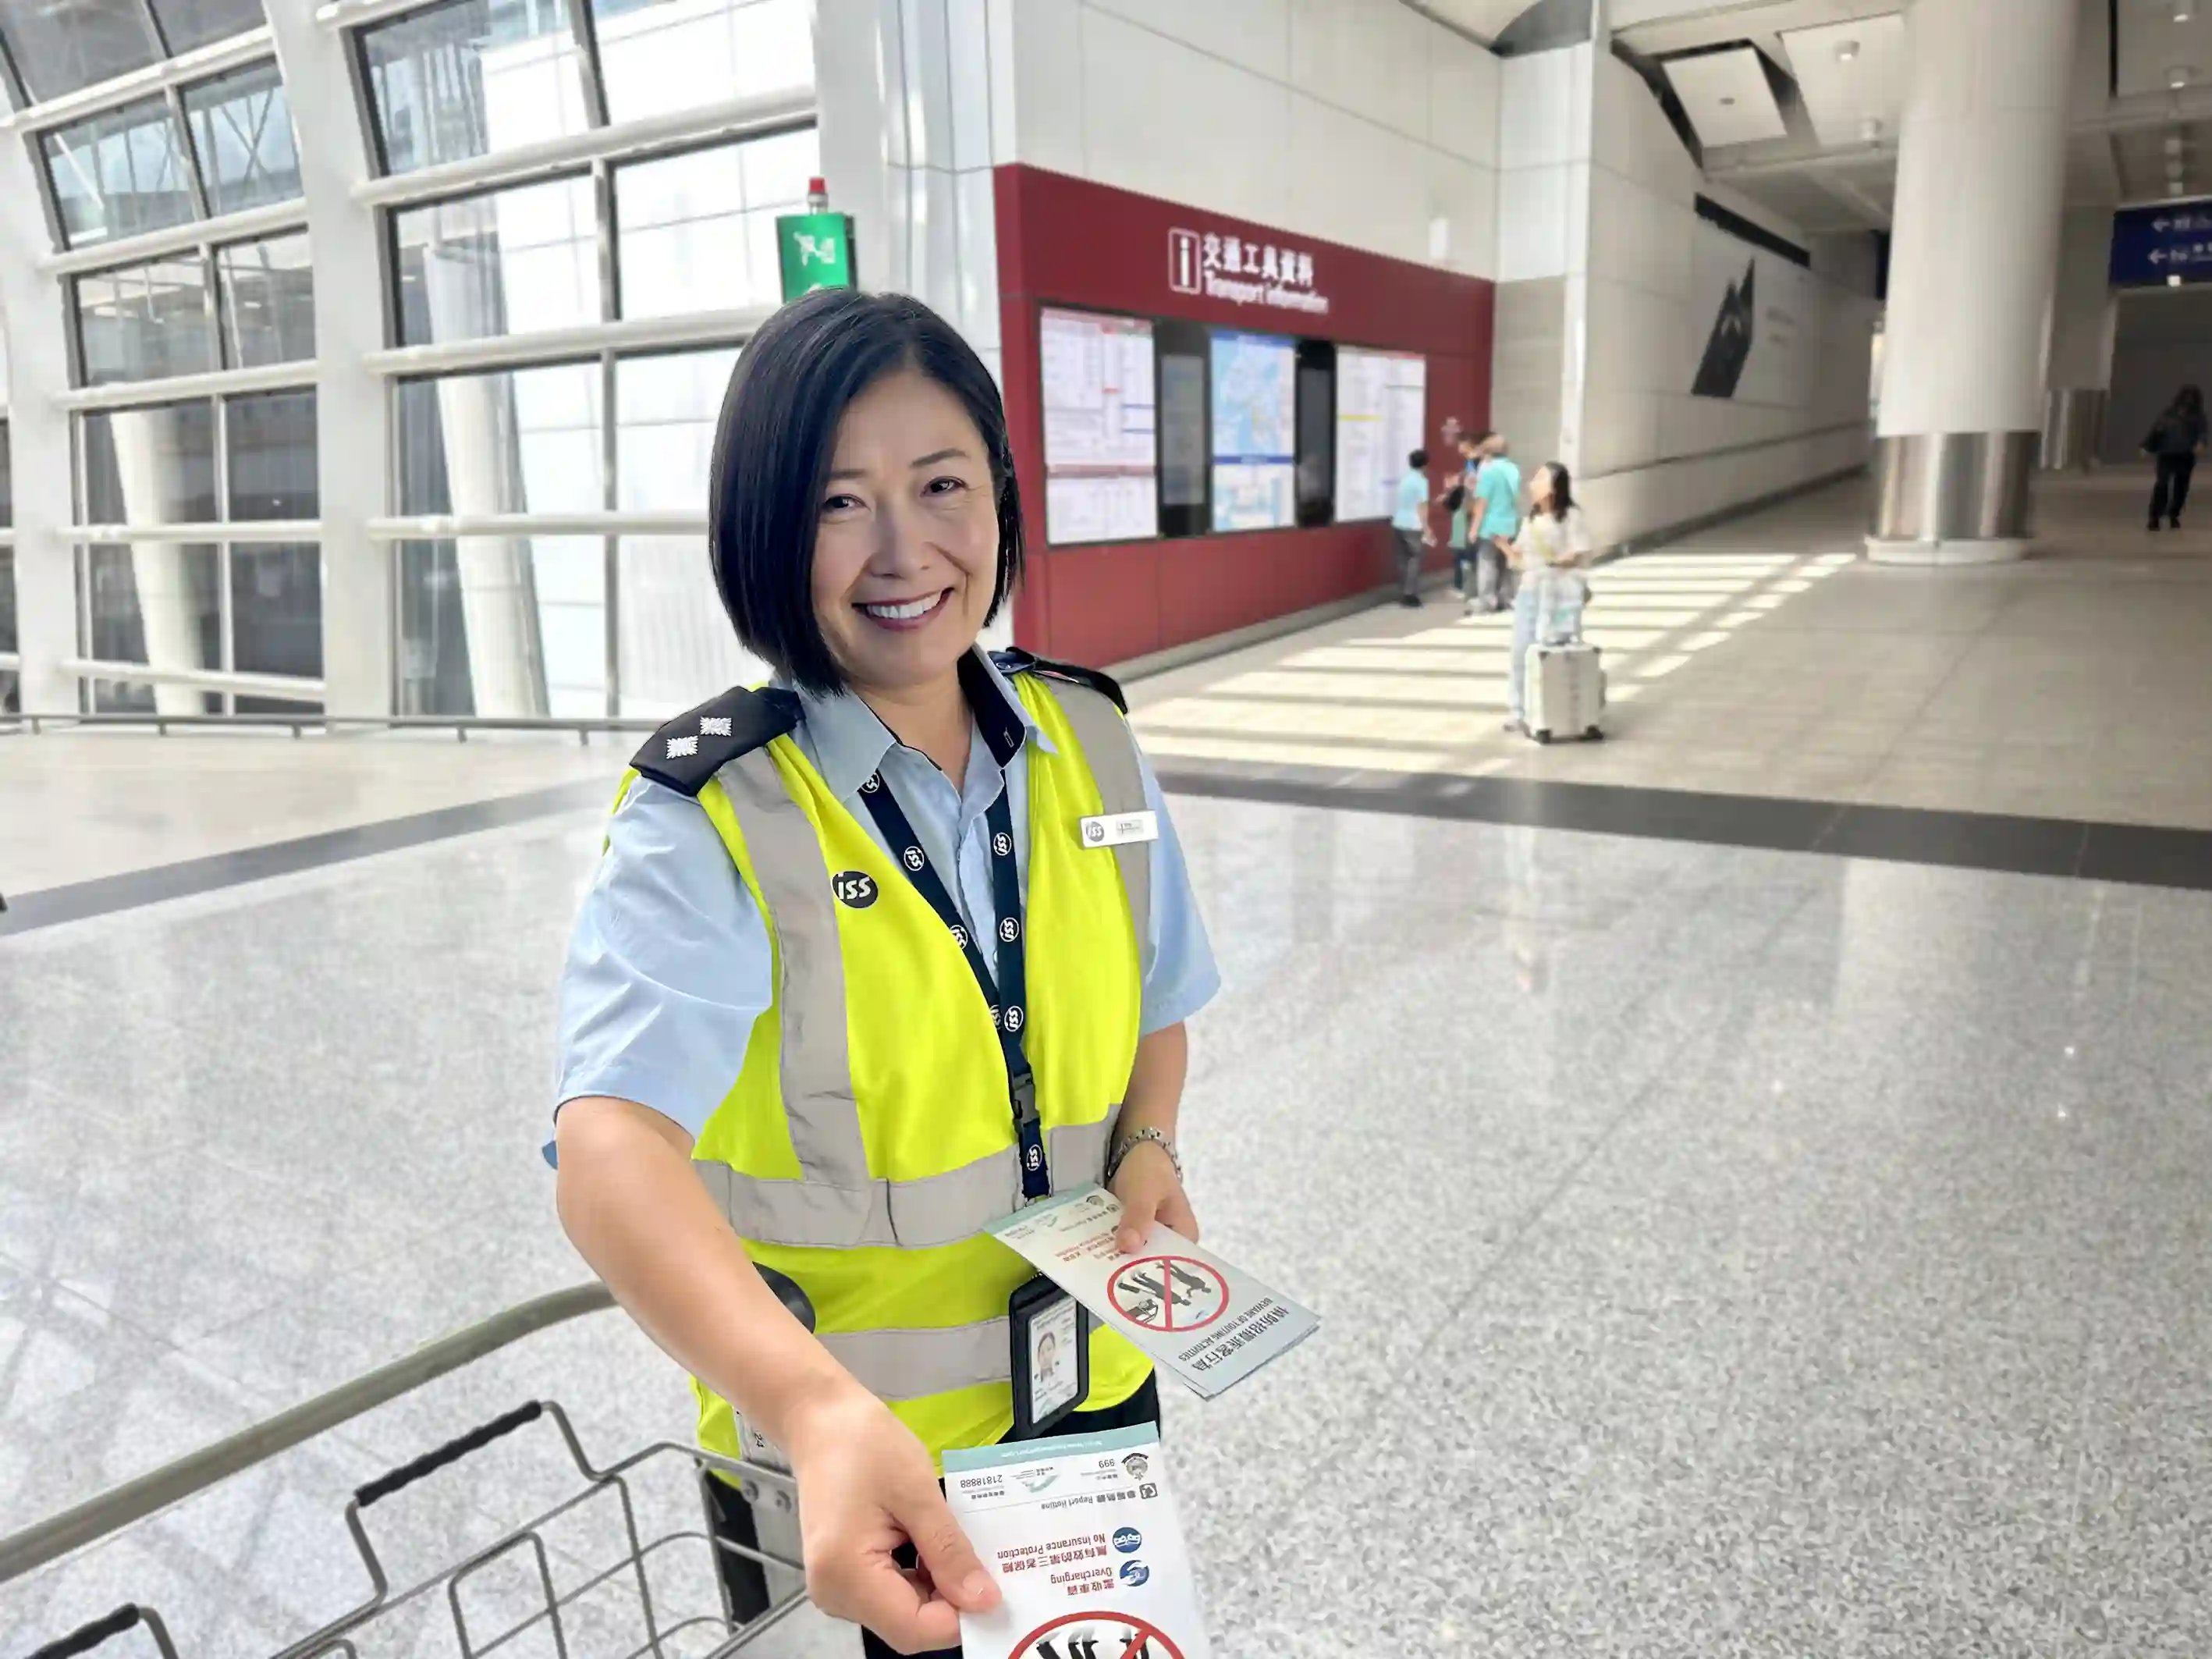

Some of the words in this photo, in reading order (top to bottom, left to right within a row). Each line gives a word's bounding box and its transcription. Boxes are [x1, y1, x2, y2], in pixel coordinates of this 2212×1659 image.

[1248, 1297, 1273, 1317] BEWARE
[1178, 1336, 1215, 1362] ACTIVITIES
[1067, 1495, 1093, 1507] Report
[1046, 1535, 1092, 1551] Insurance
[1093, 1533, 1106, 1544] No
[997, 1544, 1044, 1559] Protection
[1050, 1567, 1113, 1584] Overcharging
